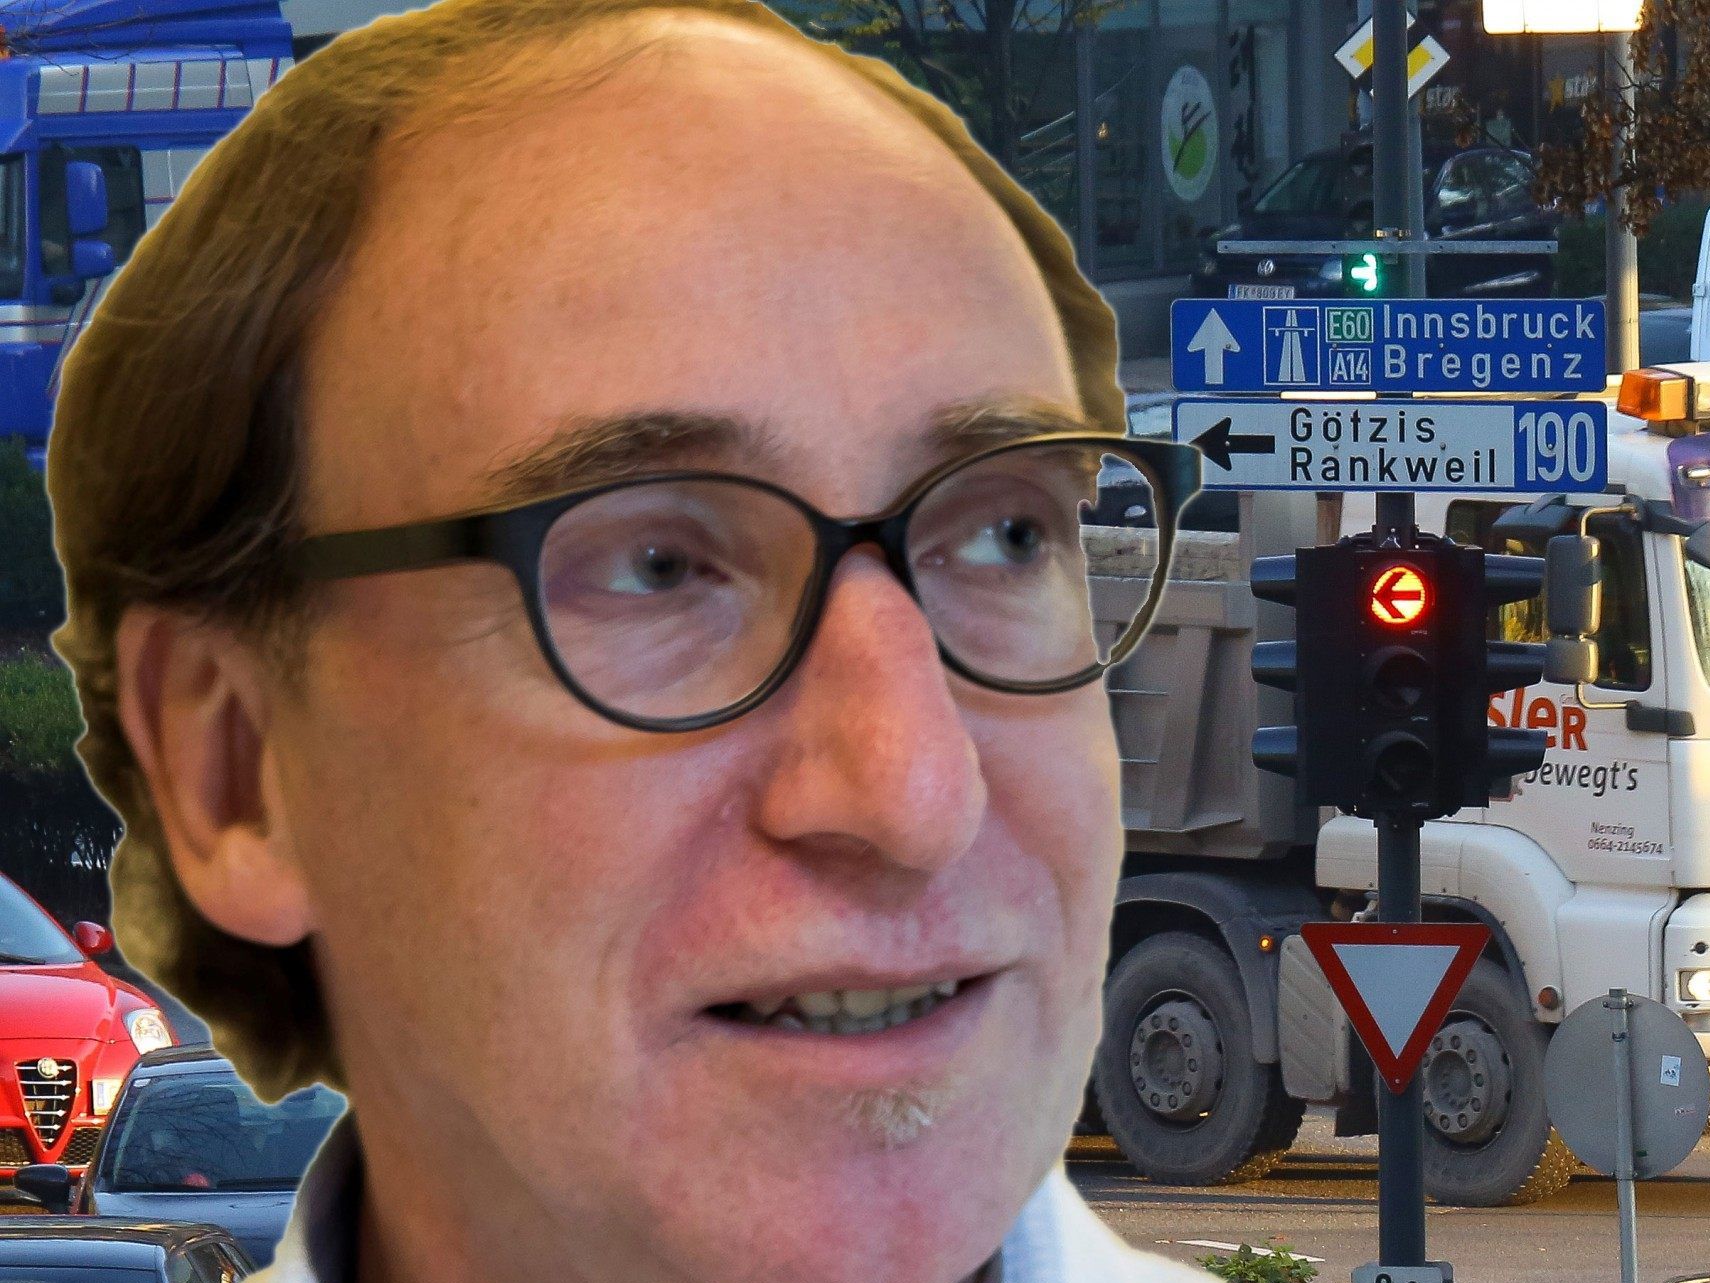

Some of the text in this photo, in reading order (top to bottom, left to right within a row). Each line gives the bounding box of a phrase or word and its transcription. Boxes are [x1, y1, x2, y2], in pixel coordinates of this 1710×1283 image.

[1328, 311, 1371, 340] E60
[1383, 304, 1595, 339] Innsbruck
[1332, 352, 1369, 381] A14
[1383, 344, 1582, 388] Bregenz
[1290, 406, 1436, 443] Götzis
[1290, 447, 1496, 482] Rankweil
[1518, 411, 1596, 483] 190
[1590, 821, 1635, 839] Nenzing
